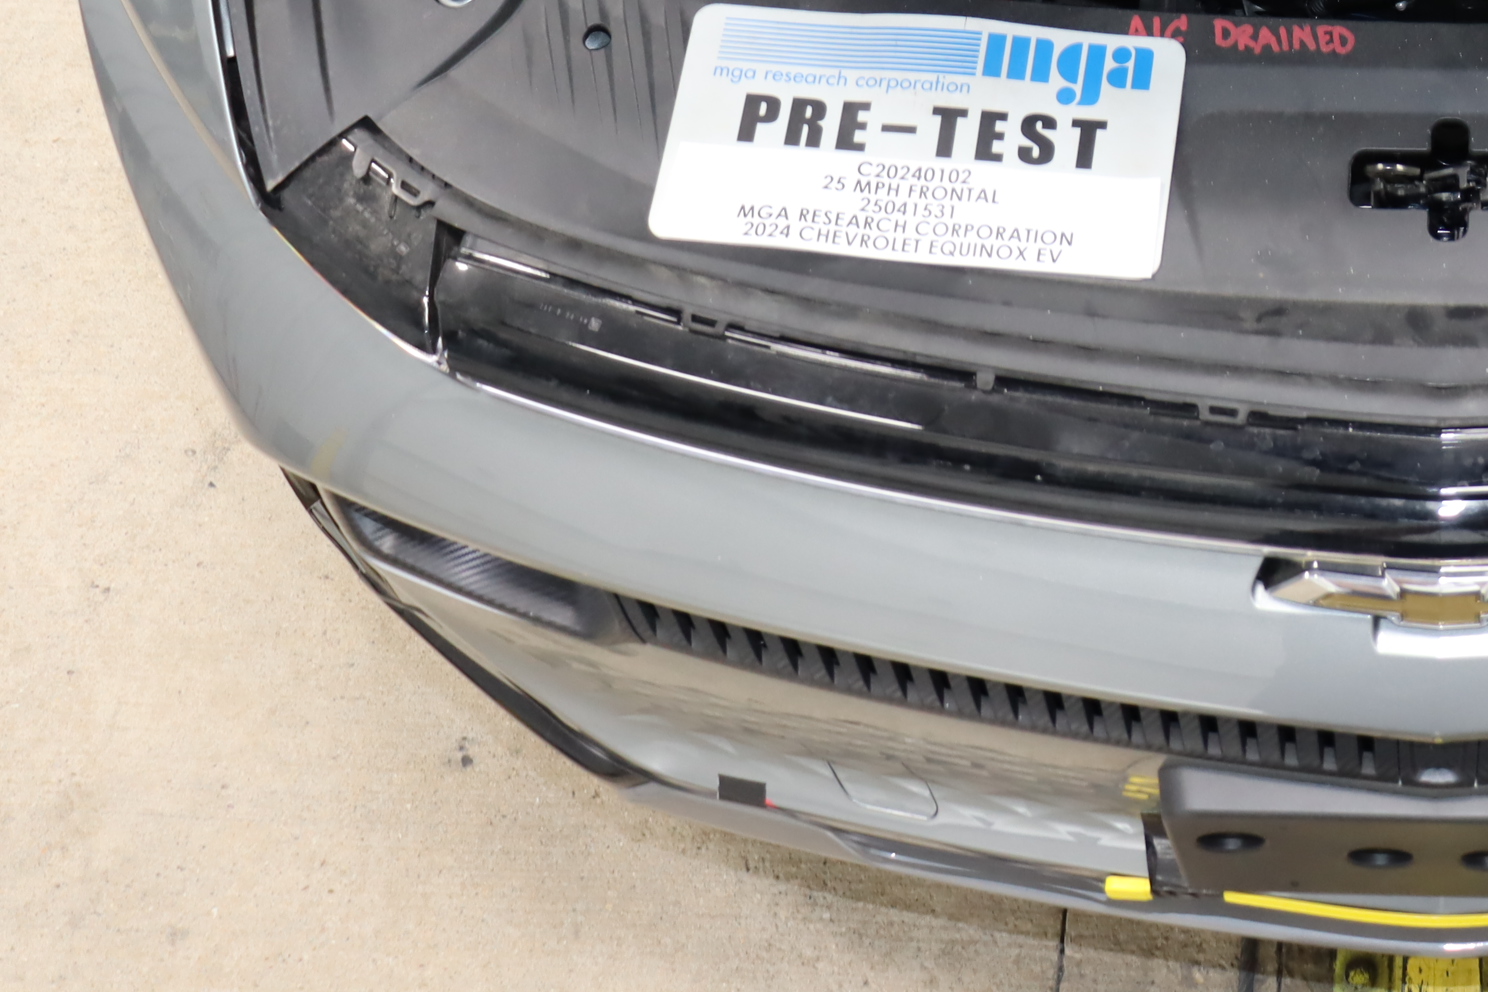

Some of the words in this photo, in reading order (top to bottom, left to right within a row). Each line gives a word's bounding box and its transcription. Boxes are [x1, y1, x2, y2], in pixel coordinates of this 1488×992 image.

[1213, 18, 1356, 55] DRAINED
[713, 65, 756, 84] mga
[764, 68, 848, 88] research
[855, 74, 972, 95] corporation
[982, 32, 1155, 106] mga
[736, 92, 1109, 170] PRE-TEST
[822, 175, 847, 191] 25
[853, 178, 900, 198] MPH
[908, 185, 1000, 205] FRONTAL
[857, 161, 972, 185] C20240102
[737, 204, 790, 221] MGA
[798, 207, 908, 235] RESEARCH
[914, 220, 1075, 247] CORPORATION
[859, 197, 956, 220] 25041531
[742, 221, 792, 239] 2024
[798, 225, 922, 254] CHEVROLET
[929, 240, 1028, 262] EQUINOX
[1037, 248, 1063, 264] EV
